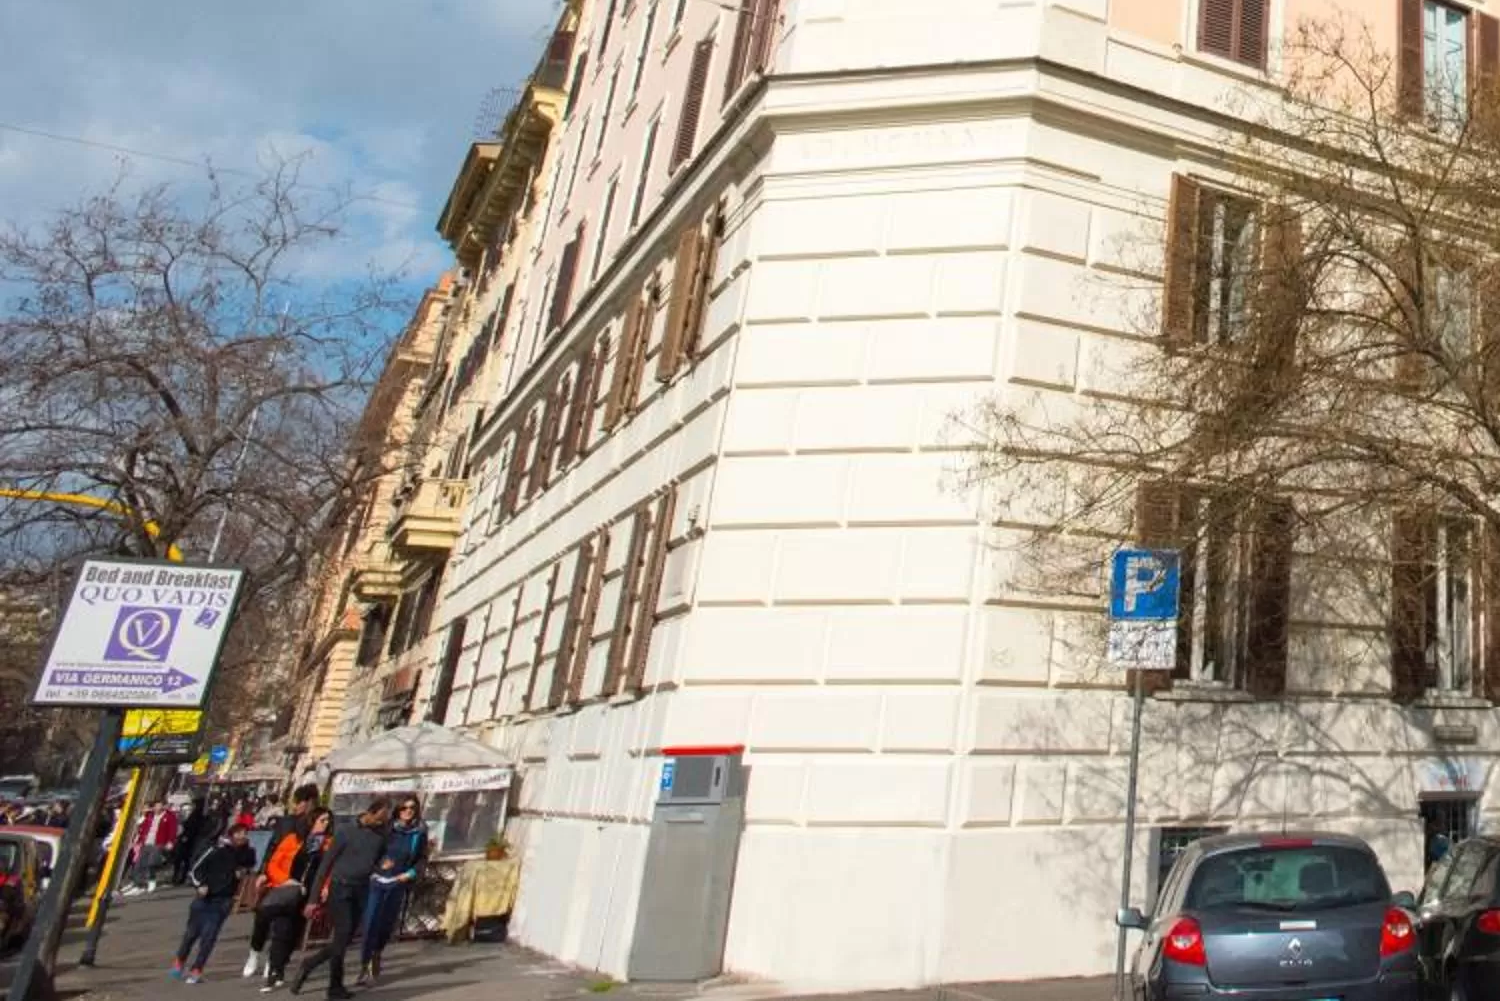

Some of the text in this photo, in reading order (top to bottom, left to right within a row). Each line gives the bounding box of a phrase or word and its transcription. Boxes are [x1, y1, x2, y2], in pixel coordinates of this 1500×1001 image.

[85, 566, 234, 591] Bed and Breakfast
[1123, 556, 1167, 612] P
[79, 585, 229, 608] QUO VADIS
[55, 672, 78, 684] VIA
[82, 673, 163, 686] GERMANICO
